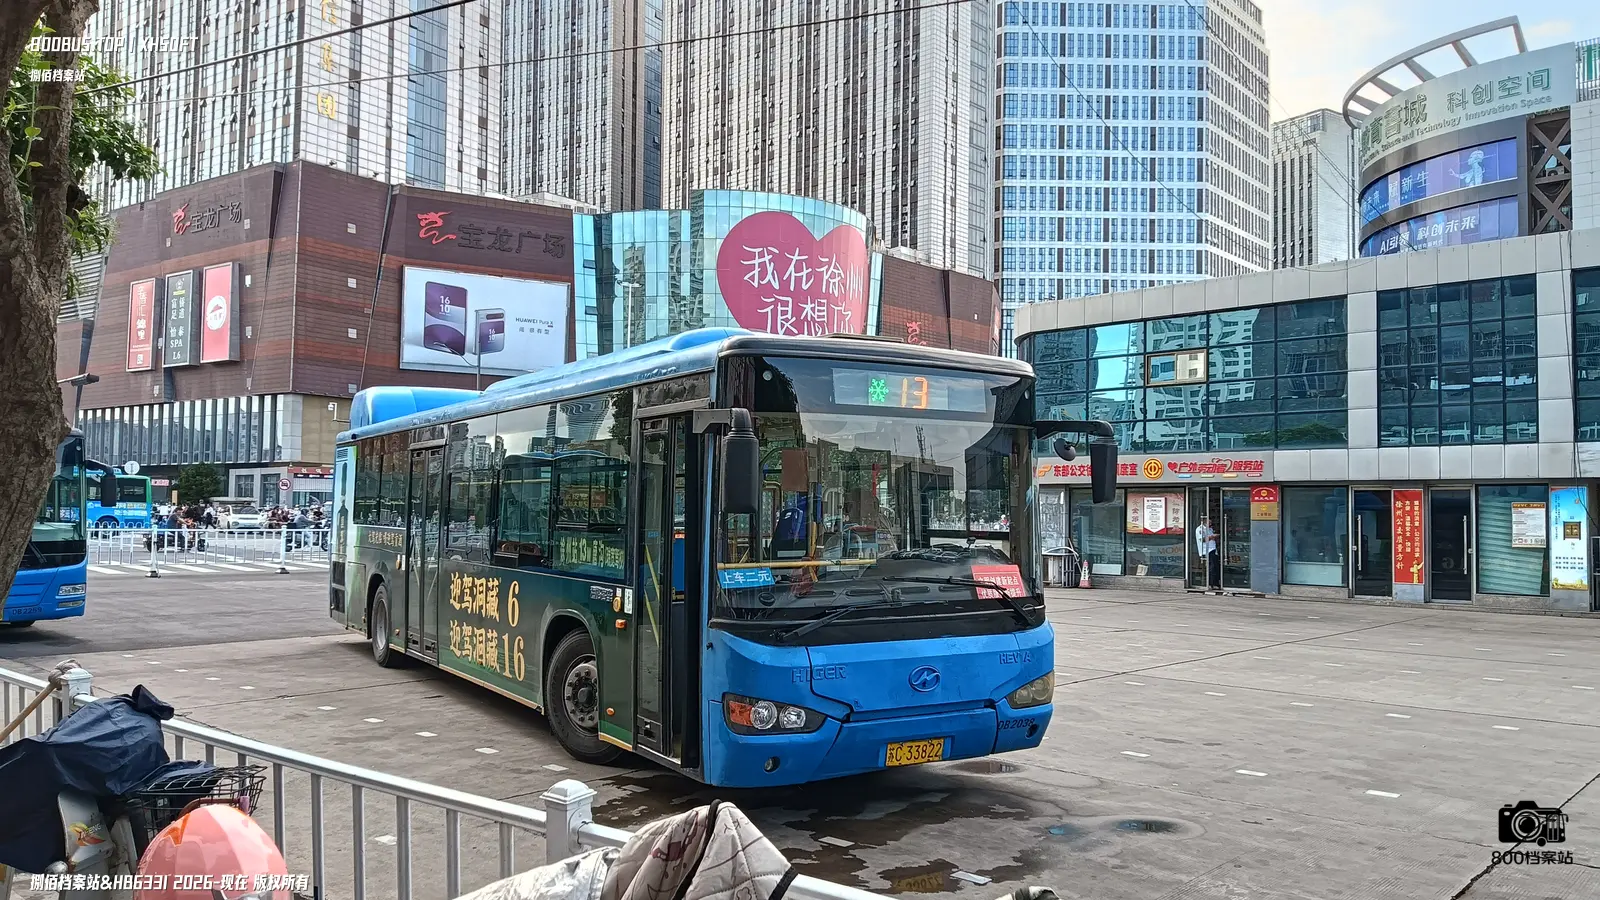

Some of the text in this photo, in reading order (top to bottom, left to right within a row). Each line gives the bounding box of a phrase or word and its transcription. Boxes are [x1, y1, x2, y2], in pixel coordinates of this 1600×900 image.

[1447, 68, 1551, 114] 科创空间
[1402, 130, 1414, 141] and
[1416, 116, 1461, 136] Technology
[1465, 102, 1518, 121] Innovation
[1520, 95, 1552, 109] Space
[190, 201, 242, 233] 宝龙广场
[1417, 216, 1476, 241] 科创未来
[457, 223, 566, 259] 宝龙广场
[740, 245, 864, 304] 我在徐州
[440, 296, 450, 305] 16
[440, 304, 450, 313] 10
[757, 295, 854, 336] 很想你
[170, 339, 183, 348] SPA
[173, 351, 181, 360] L6
[901, 376, 929, 409] 13
[1177, 459, 1265, 474] 户外劳动者服务站
[723, 571, 771, 584] 上车二元
[450, 572, 519, 628] 迎驾洞藏 6
[450, 620, 525, 682] 迎驾洞藏 16
[791, 664, 847, 685] HIGER
[998, 717, 1035, 730] DB2038
